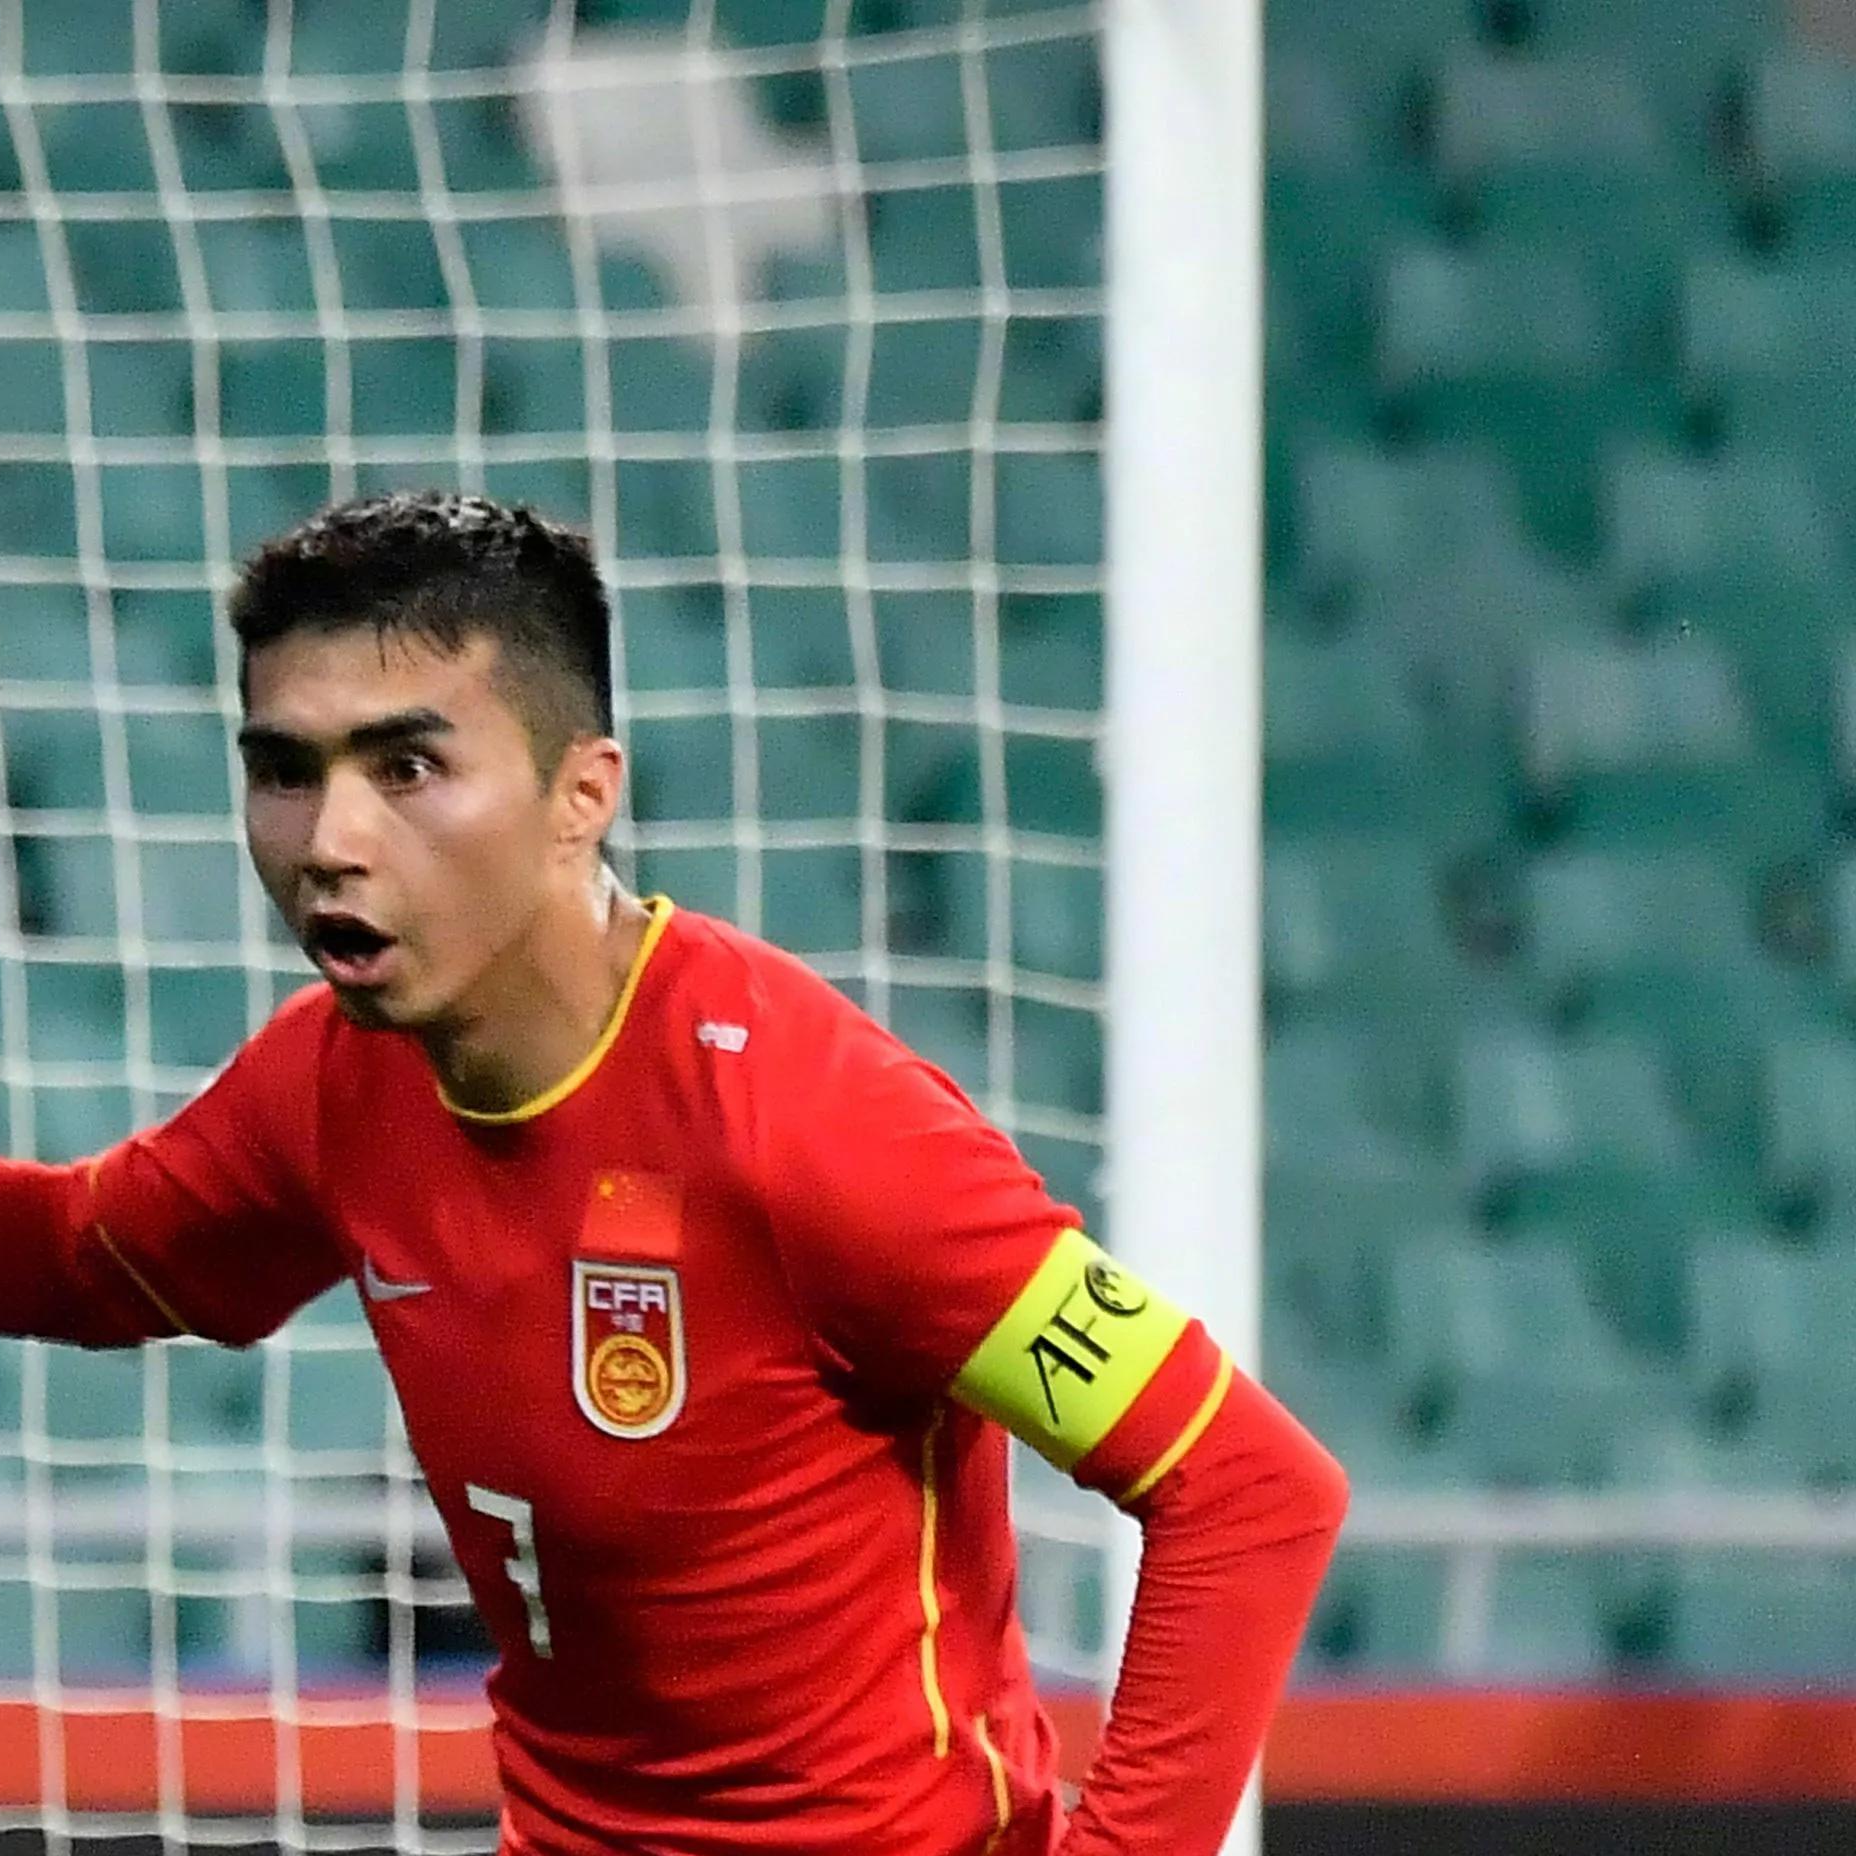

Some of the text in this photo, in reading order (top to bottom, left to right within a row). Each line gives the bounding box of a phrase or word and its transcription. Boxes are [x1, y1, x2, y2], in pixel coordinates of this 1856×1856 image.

[587, 1280, 667, 1313] CFA
[1024, 1260, 1148, 1425] AFC
[465, 1483, 556, 1662] 7
